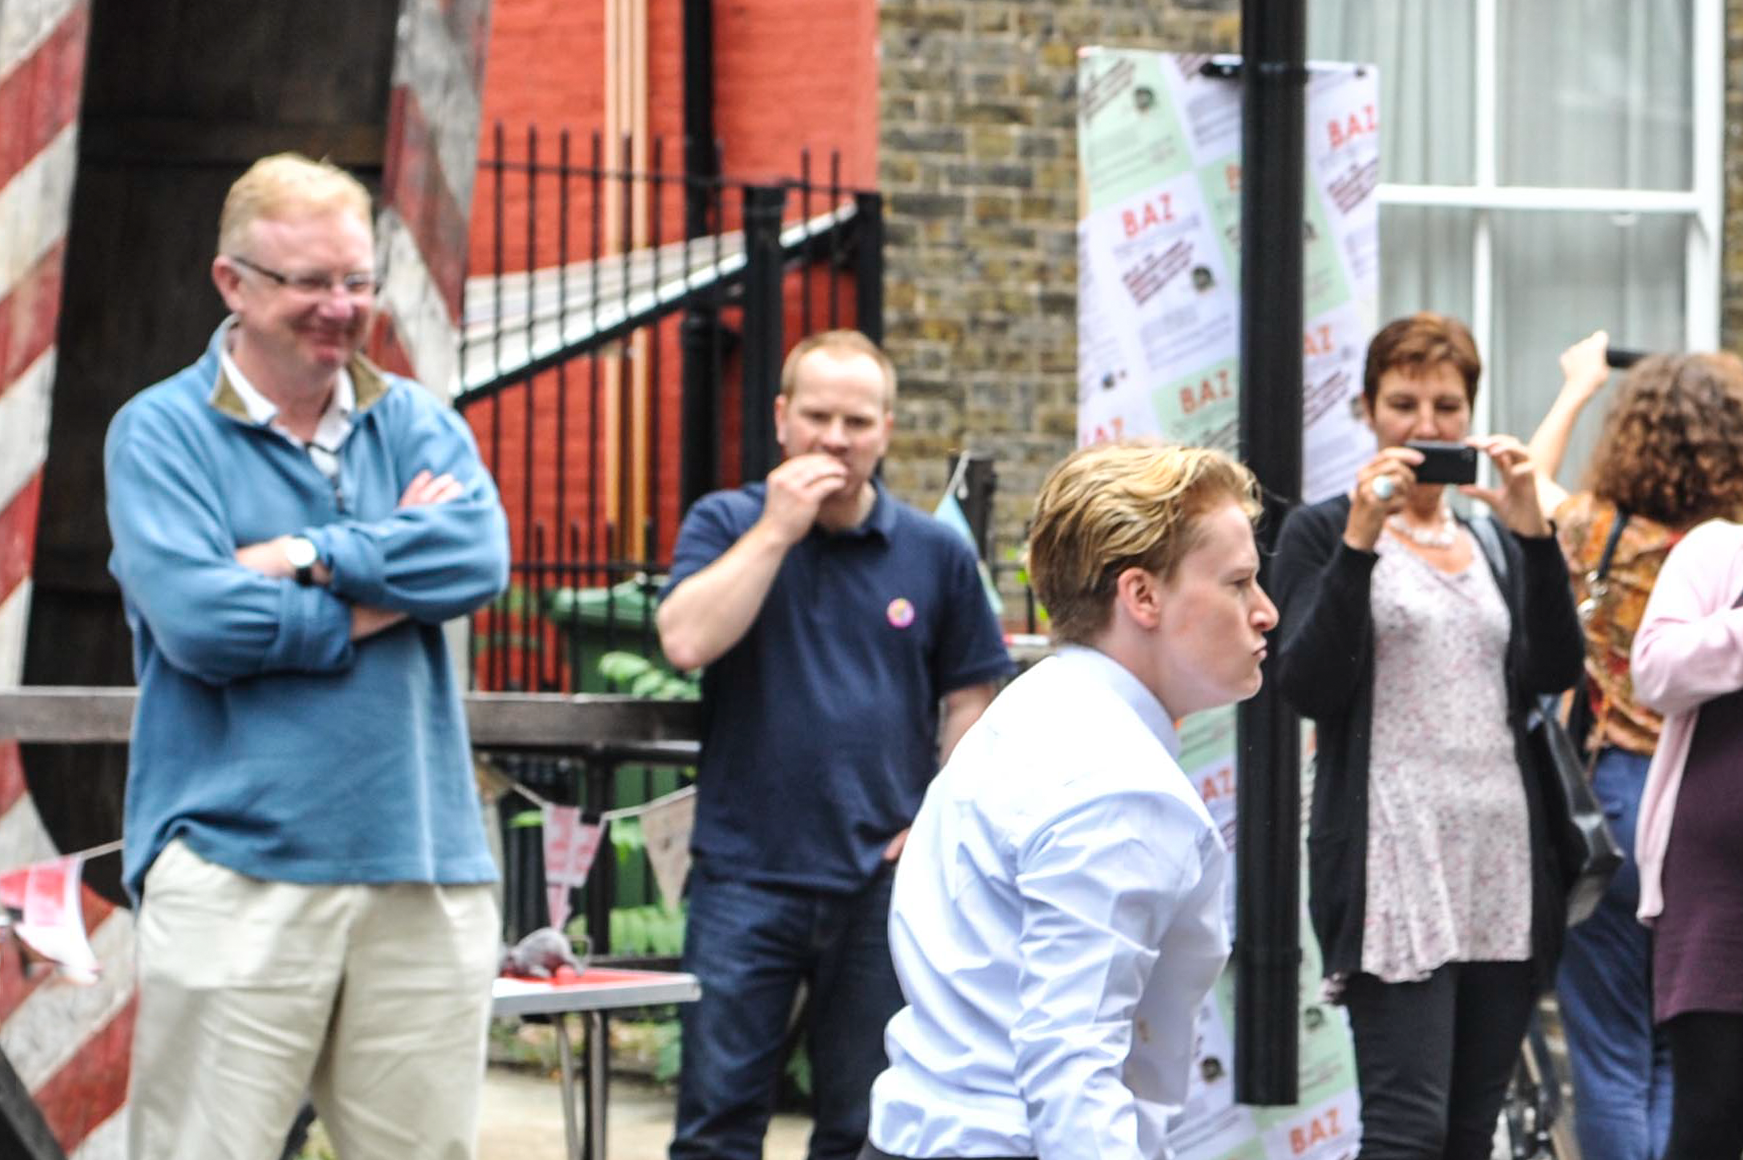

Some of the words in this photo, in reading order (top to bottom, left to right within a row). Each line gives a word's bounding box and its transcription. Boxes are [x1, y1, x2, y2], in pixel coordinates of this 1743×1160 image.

[1328, 106, 1378, 147] BAZ
[1122, 193, 1175, 238] BAZ
[1304, 325, 1334, 355] AZ
[1179, 370, 1233, 414] BAZ
[1202, 768, 1236, 803] AZ
[1290, 1109, 1342, 1154] BAZ
